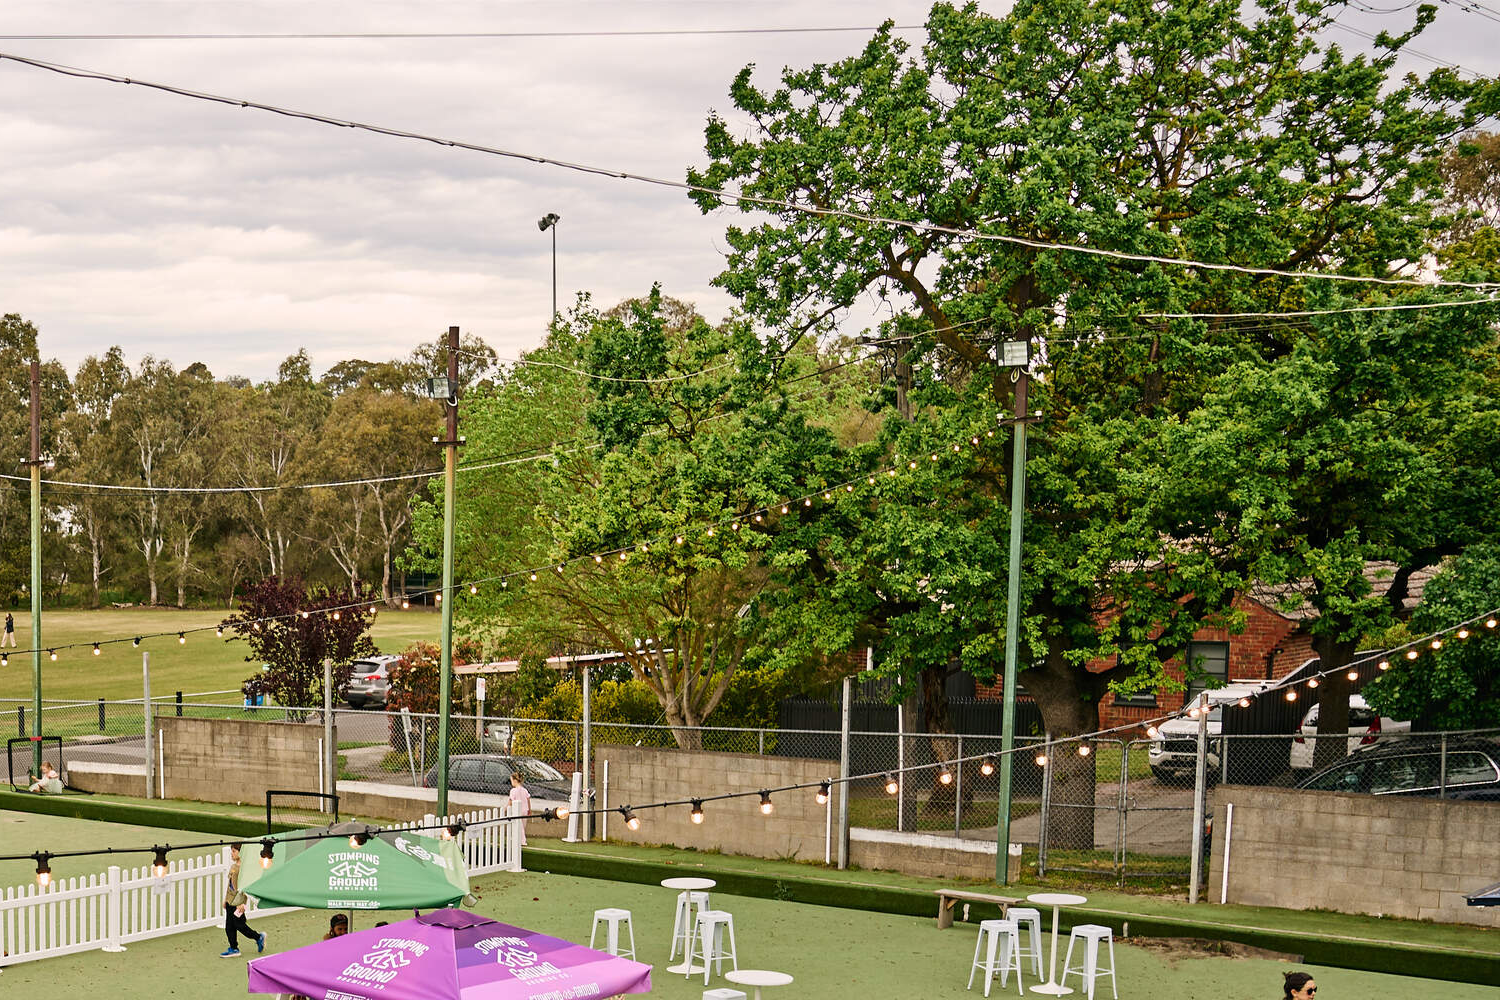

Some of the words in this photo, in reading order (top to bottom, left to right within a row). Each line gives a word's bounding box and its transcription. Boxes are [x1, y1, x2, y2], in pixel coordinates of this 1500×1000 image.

[328, 852, 379, 865] STOMPING
[329, 876, 378, 887] GROUND
[372, 938, 430, 957] STOMPING
[474, 936, 529, 955] STOMPING
[342, 962, 398, 983] GROUND
[508, 961, 562, 980] GROUND
